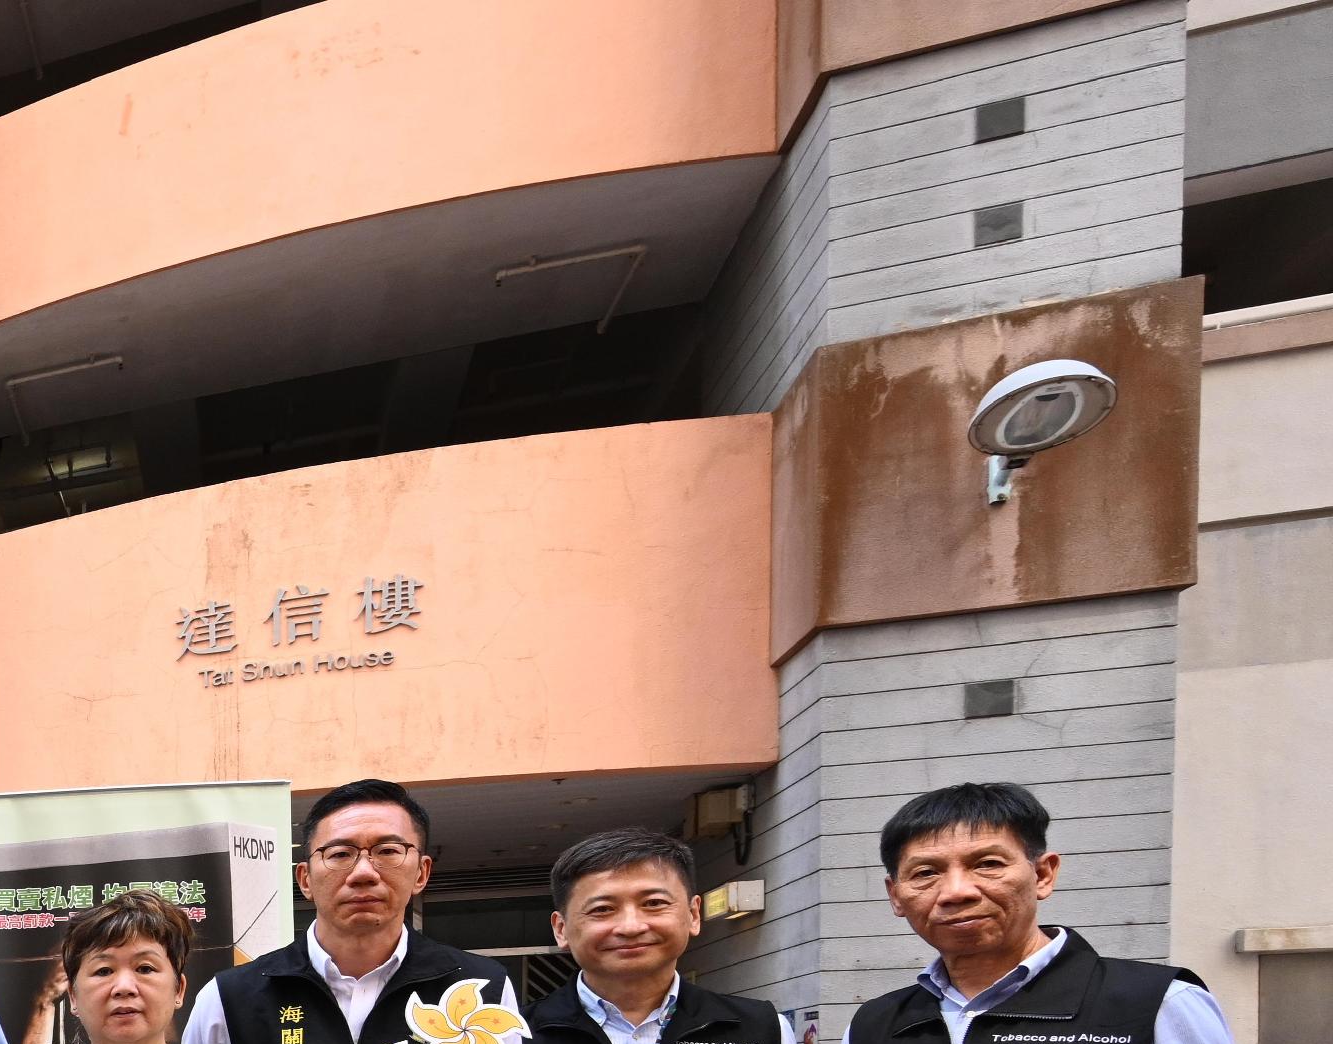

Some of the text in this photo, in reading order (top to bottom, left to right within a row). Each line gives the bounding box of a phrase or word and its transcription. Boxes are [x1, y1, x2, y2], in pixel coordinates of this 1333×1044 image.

[175, 574, 424, 662] 達信樓
[199, 649, 395, 688] Tat Shun House
[233, 836, 275, 861] HKDNP
[992, 1034, 1131, 1044] Tobacco and Alcohol
